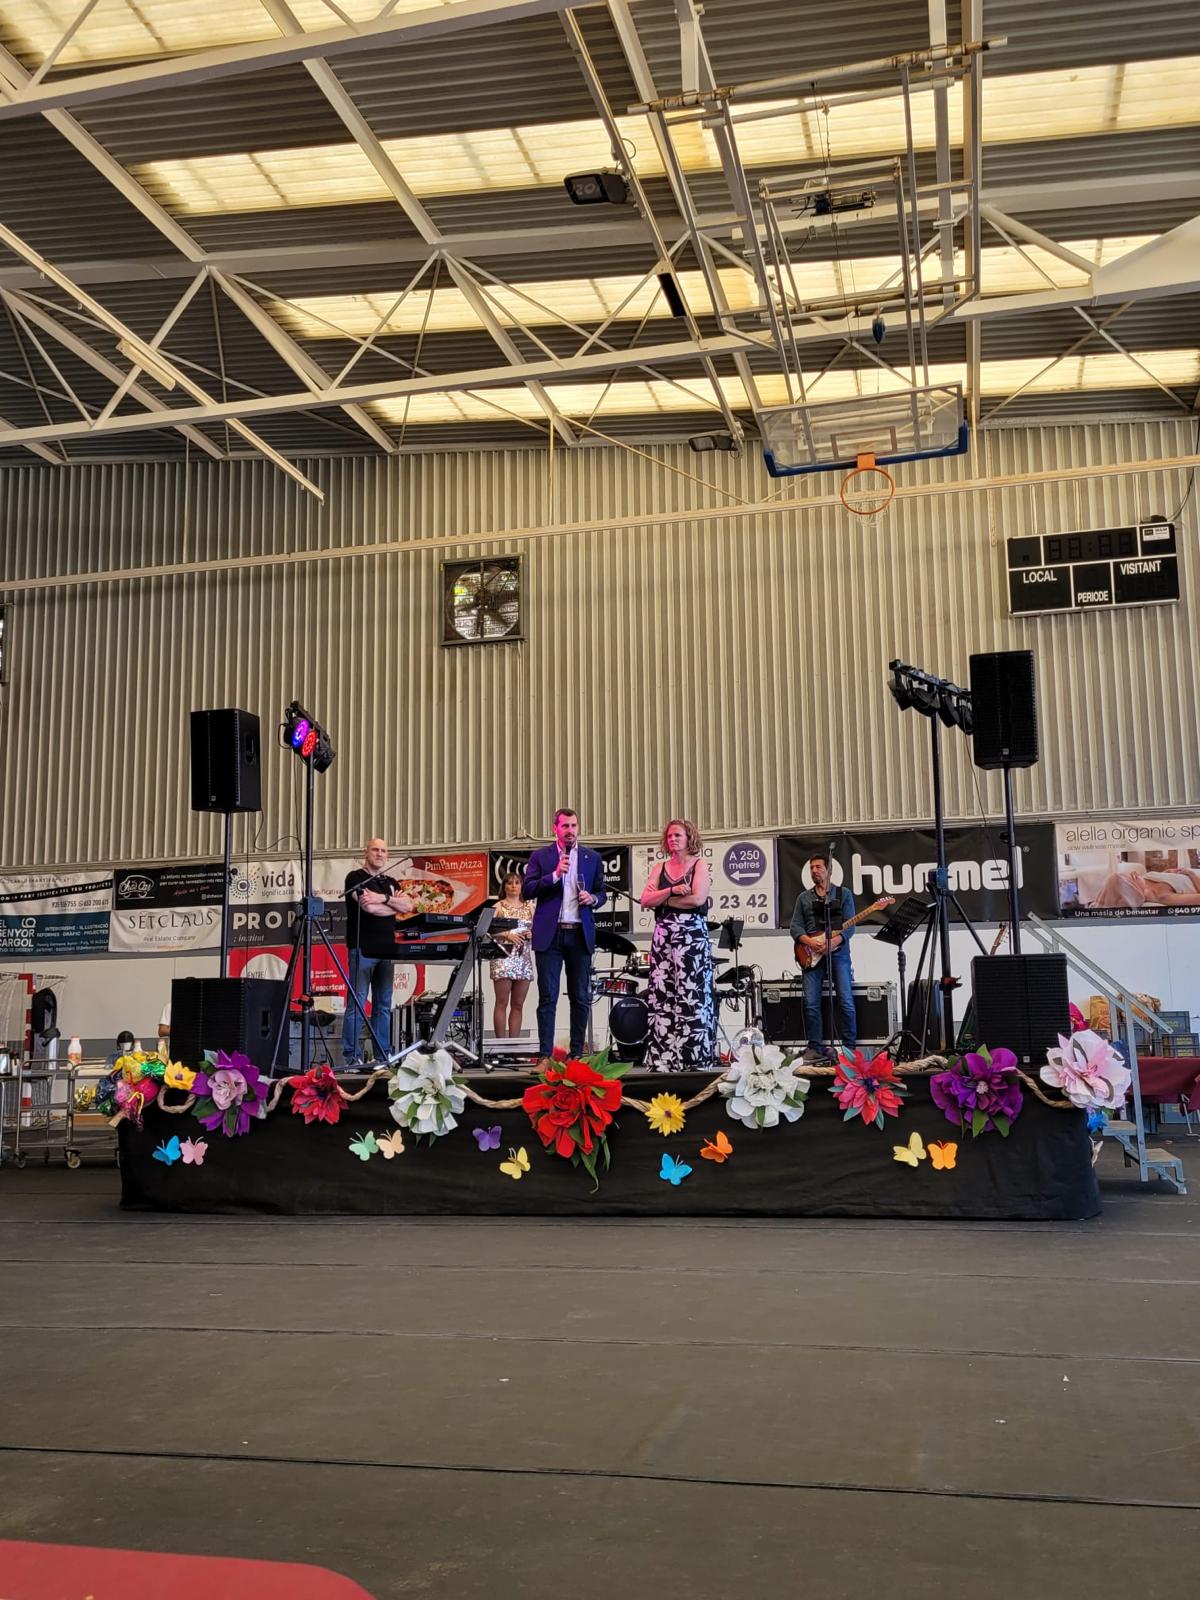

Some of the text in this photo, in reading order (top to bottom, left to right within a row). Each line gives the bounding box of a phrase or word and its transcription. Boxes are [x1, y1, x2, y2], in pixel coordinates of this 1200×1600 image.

[1120, 560, 1162, 576] VISITANT
[1023, 570, 1057, 583] LOCAL
[1077, 591, 1109, 603] PERIODE
[1066, 824, 1200, 842] alella organic sp
[729, 850, 760, 861] A 250
[458, 858, 483, 871] pizza
[602, 854, 620, 873] nd
[728, 862, 760, 870] metres
[261, 870, 294, 888] vida
[720, 895, 740, 909] 23
[746, 894, 767, 908] 42
[1115, 909, 1124, 917] de
[1175, 907, 1189, 915] 640
